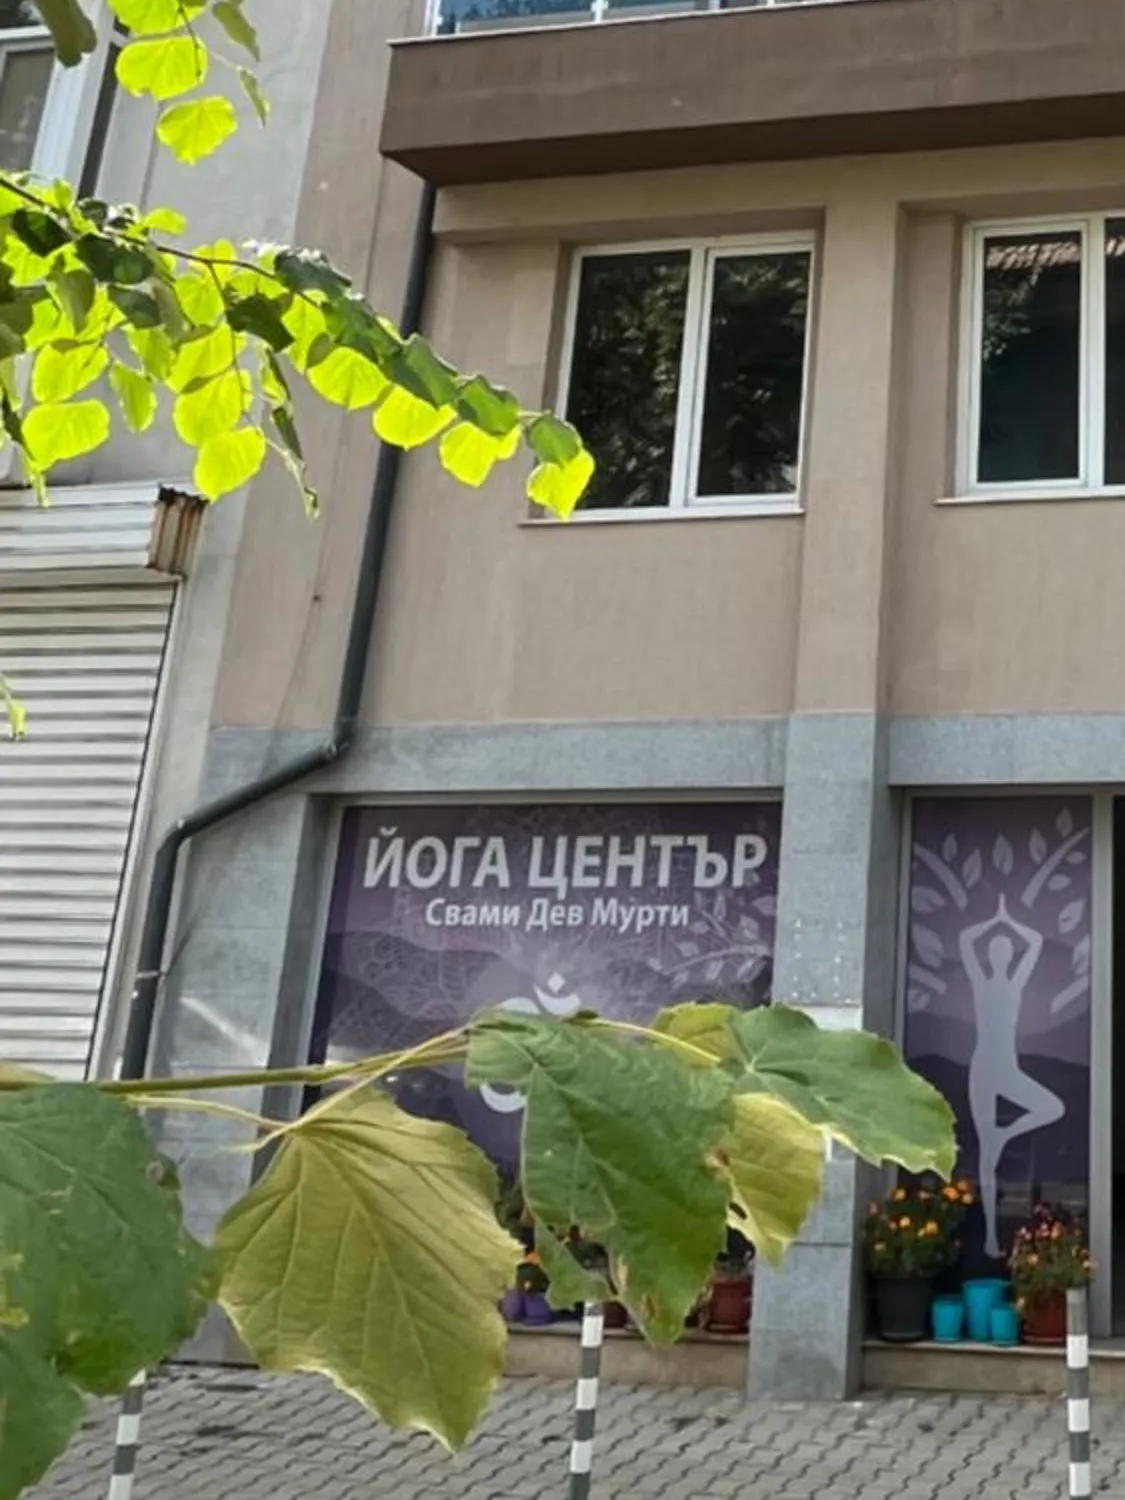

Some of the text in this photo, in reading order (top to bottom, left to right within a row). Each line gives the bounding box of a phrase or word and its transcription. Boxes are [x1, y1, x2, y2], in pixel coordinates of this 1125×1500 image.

[363, 826, 768, 900] ЙОГА ЦЕНТЪР
[425, 896, 690, 935] Свами Дев Мурти
